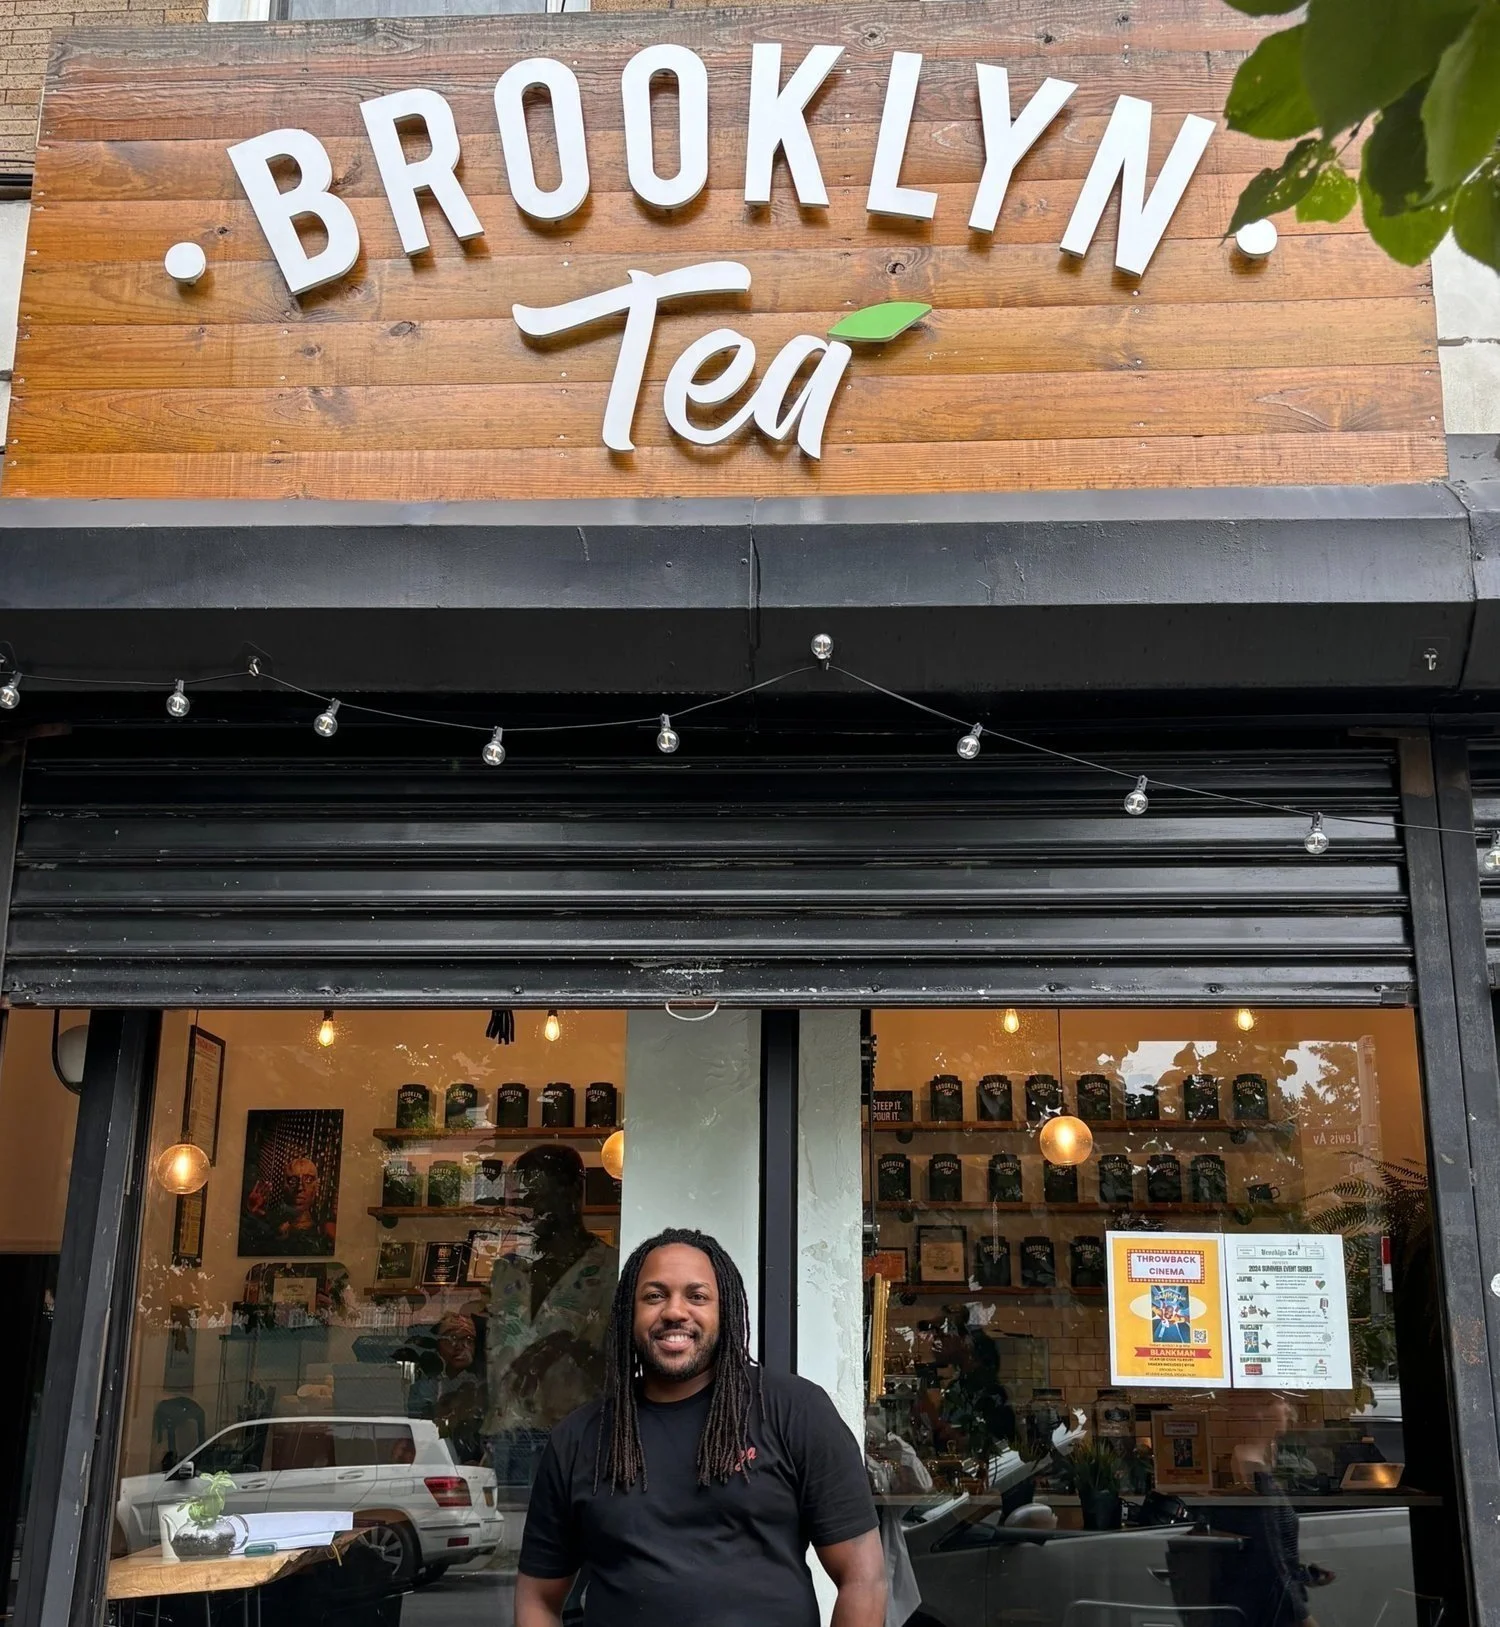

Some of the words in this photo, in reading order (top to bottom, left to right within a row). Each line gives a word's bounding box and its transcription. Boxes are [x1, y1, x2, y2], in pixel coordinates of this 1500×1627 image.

[227, 43, 1216, 296] BROOKLYN
[512, 261, 853, 461] Tea
[873, 1101, 894, 1111] STEEP
[873, 1112, 890, 1120] POUR
[892, 1112, 900, 1120] IT.
[1137, 1256, 1196, 1264] THROWBACK
[1150, 1268, 1184, 1276] CINEMA
